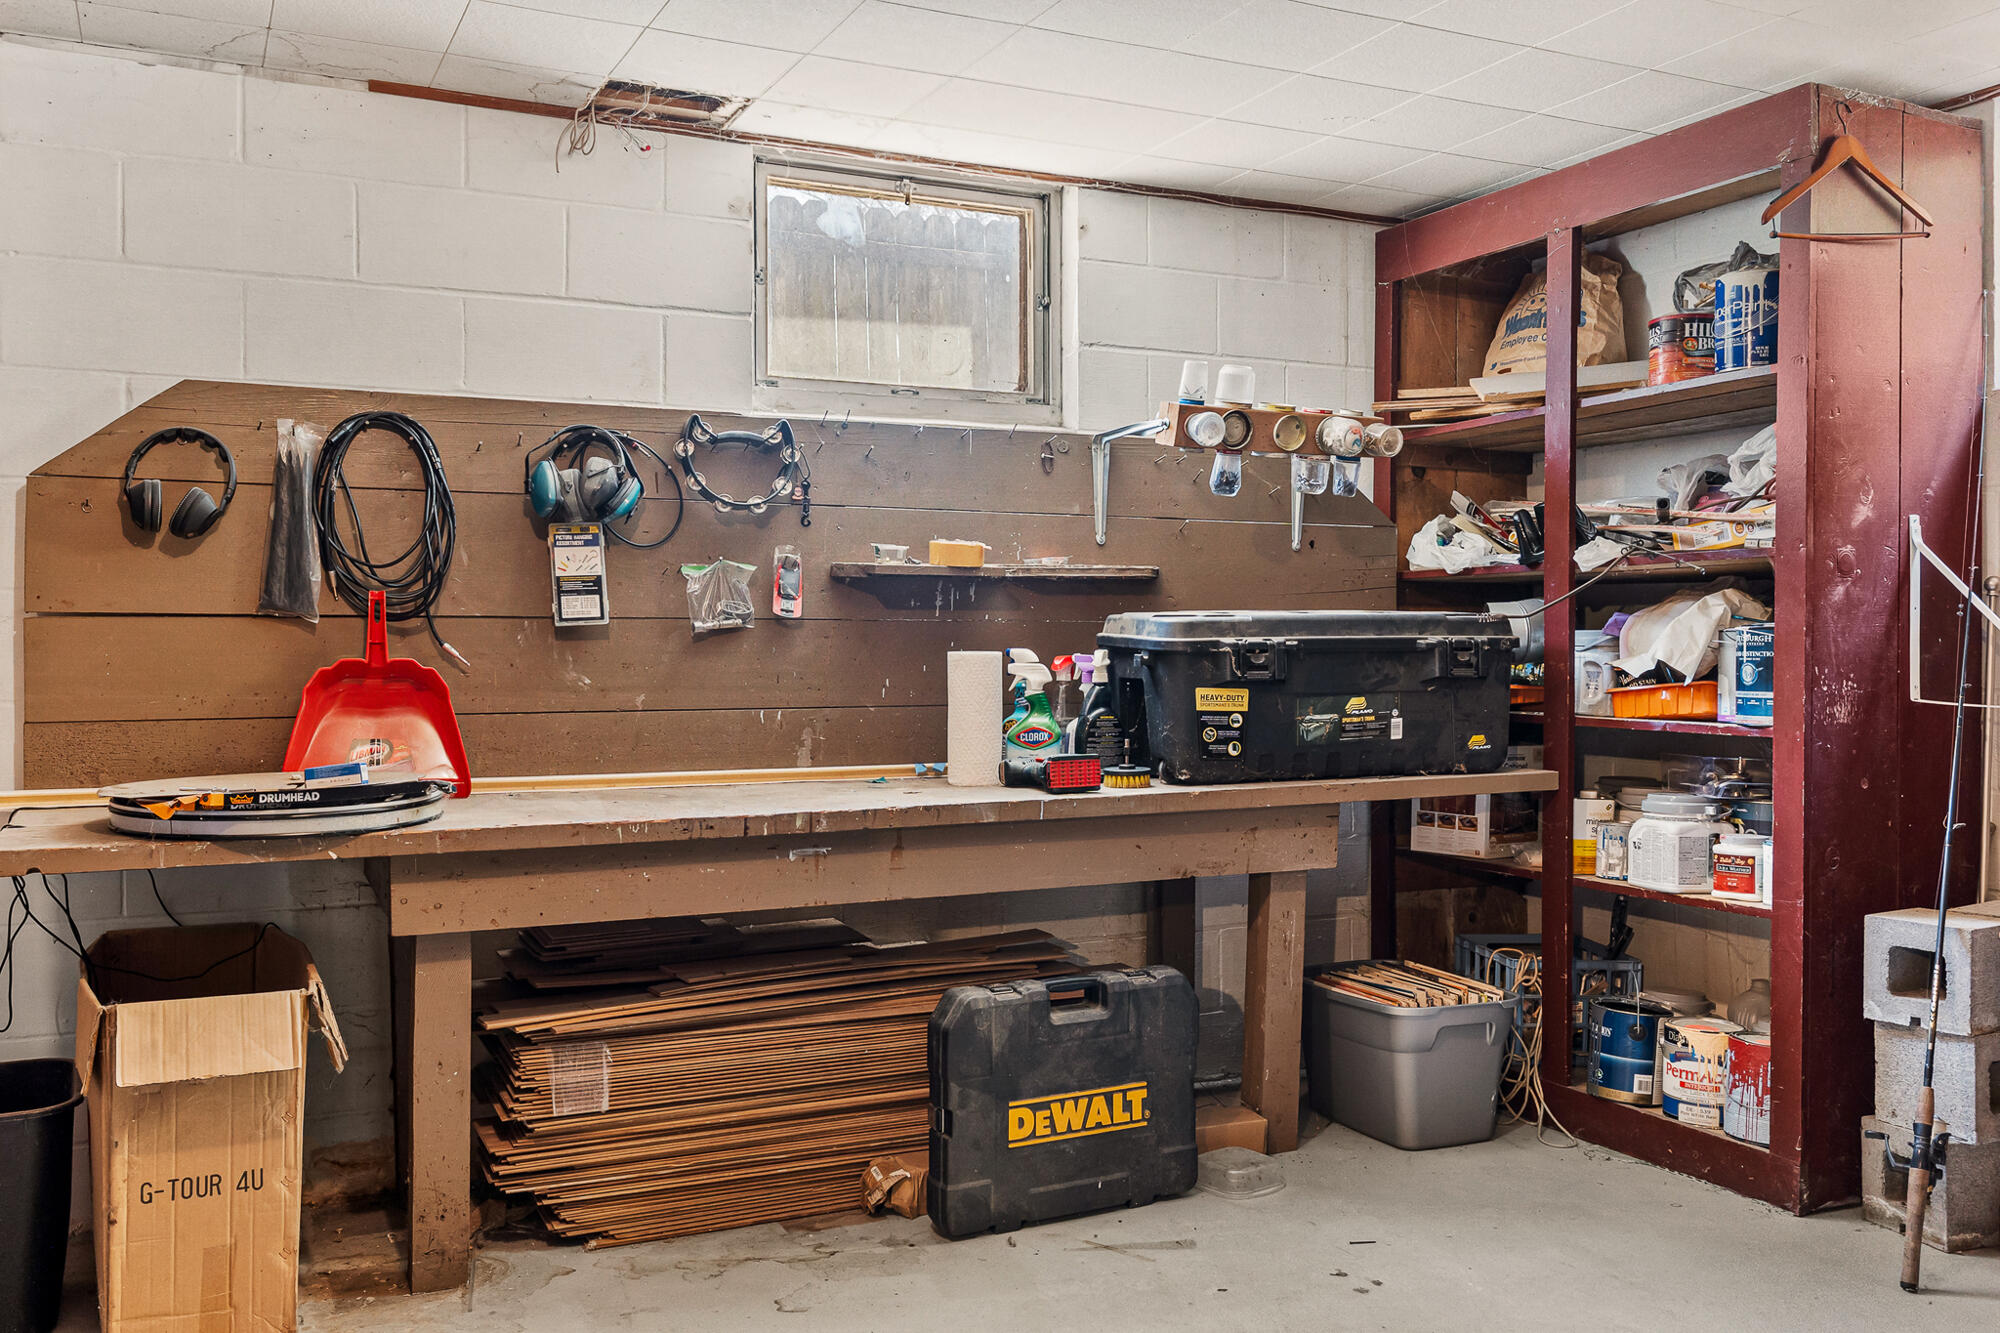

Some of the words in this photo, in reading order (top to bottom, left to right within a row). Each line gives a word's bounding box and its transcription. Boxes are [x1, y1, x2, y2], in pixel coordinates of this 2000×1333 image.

[1500, 334, 1539, 350] Employee
[1200, 693, 1245, 701] HEAVY-DUTY
[1020, 731, 1050, 742] CLOROX
[259, 791, 320, 804] DRUMHEAD
[140, 1173, 222, 1205] G-TOUR
[236, 1167, 264, 1192] 4U
